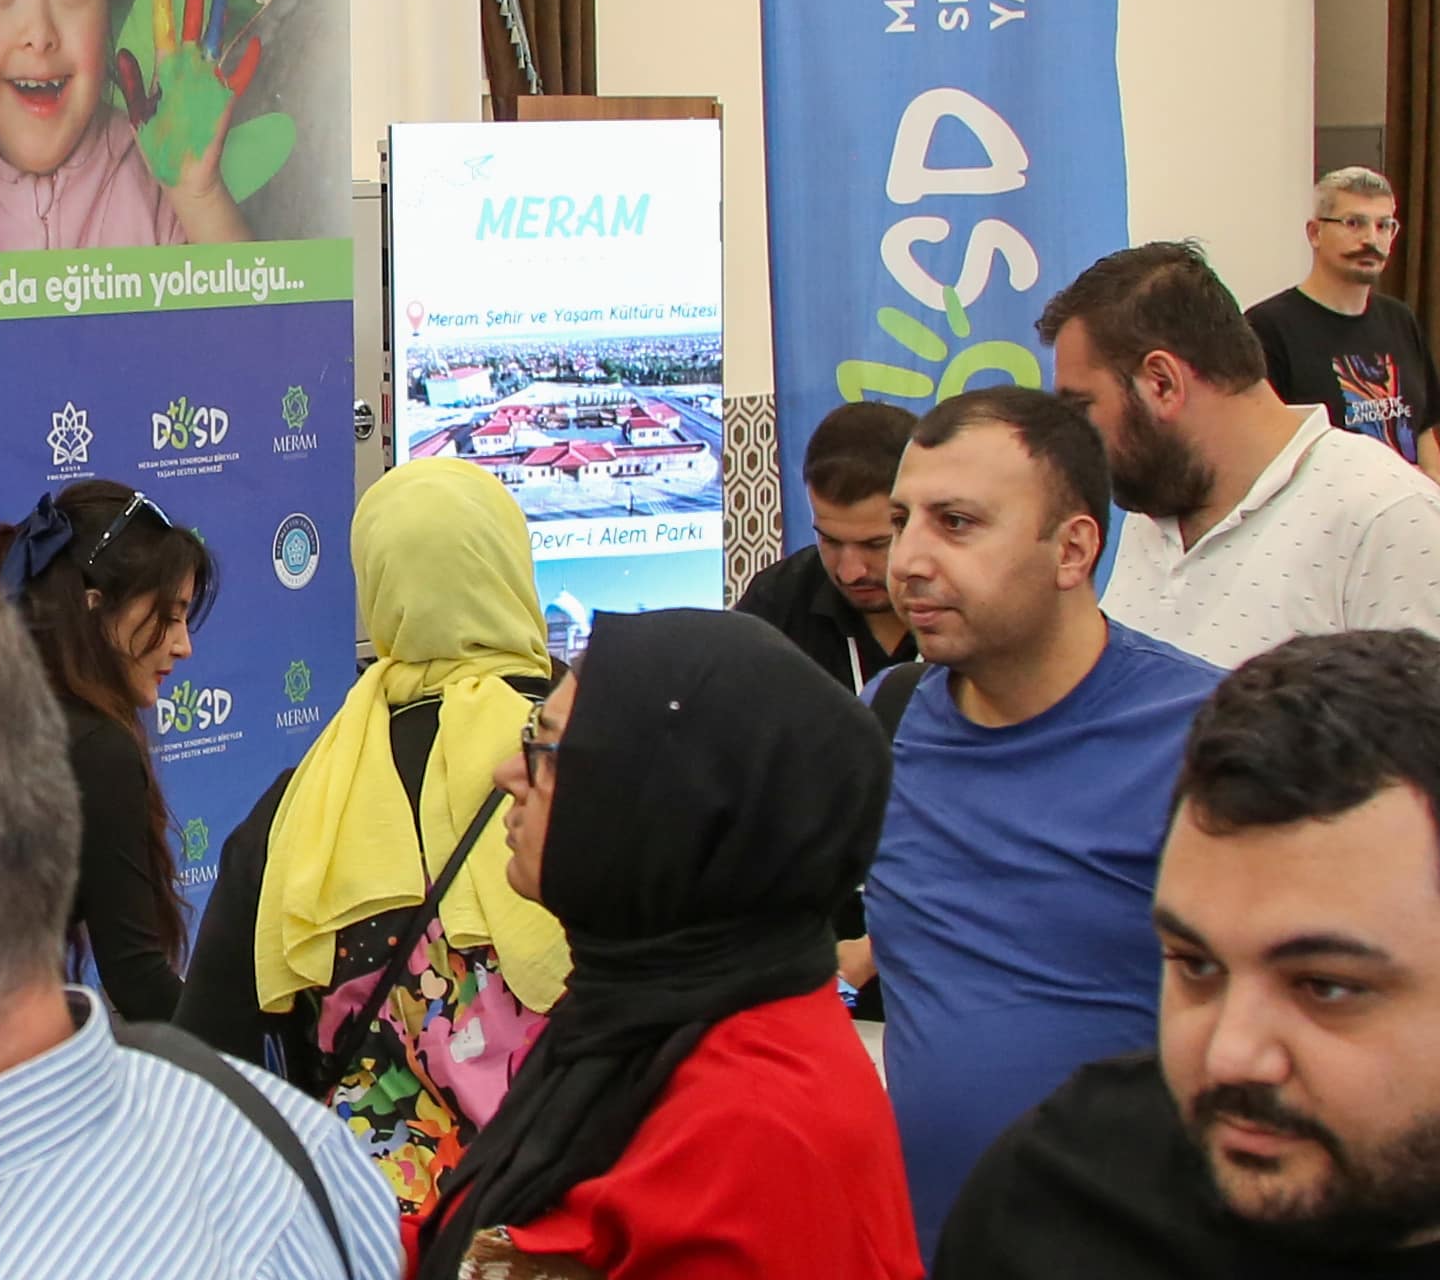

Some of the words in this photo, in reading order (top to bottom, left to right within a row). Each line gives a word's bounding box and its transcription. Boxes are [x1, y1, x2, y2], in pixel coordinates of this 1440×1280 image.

[475, 193, 652, 241] MERAM
[46, 261, 143, 313] eğitim
[149, 255, 306, 308] yolculuğu...
[426, 312, 479, 327] Meram
[485, 308, 523, 328] Şehir
[530, 312, 549, 324] ve
[554, 307, 604, 326] Yaşam
[610, 304, 665, 320] Kültürü
[670, 302, 718, 318] Müzesi
[273, 433, 318, 454] MERAM
[599, 526, 648, 546] Alem
[275, 706, 320, 730] MERAM
